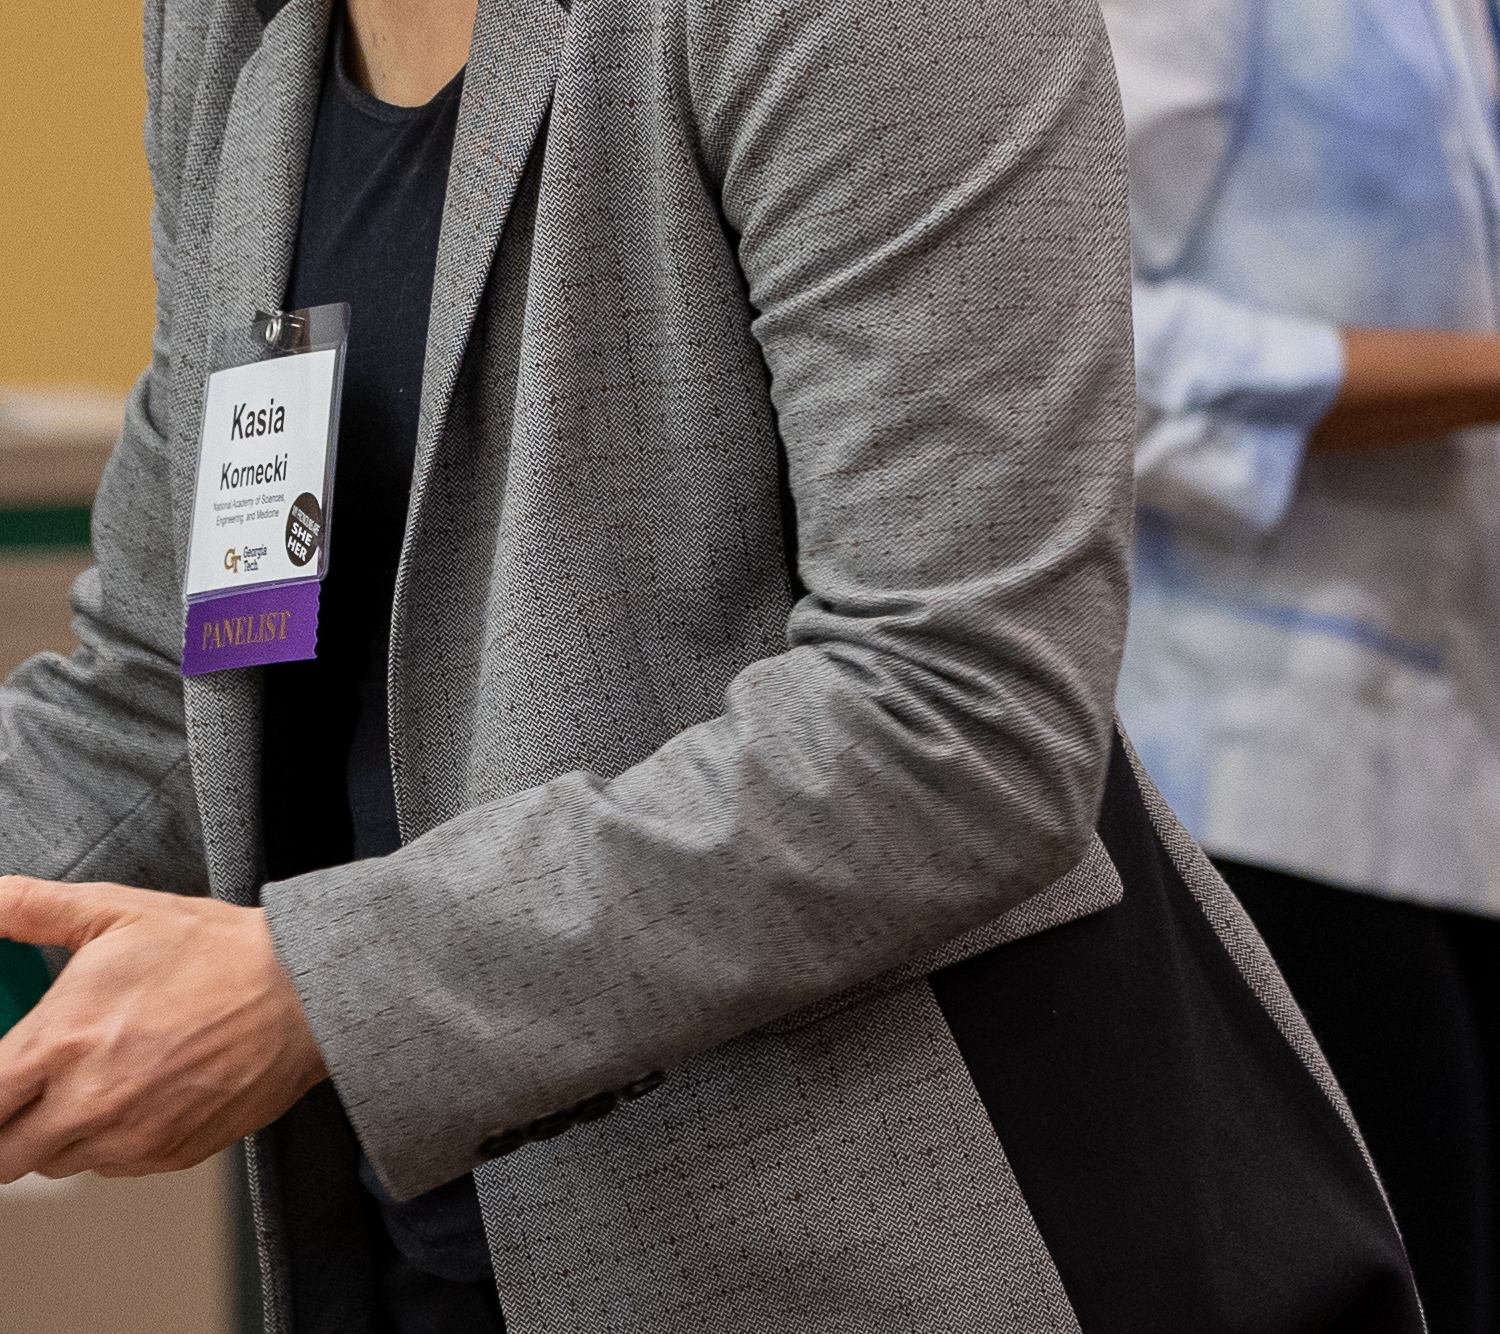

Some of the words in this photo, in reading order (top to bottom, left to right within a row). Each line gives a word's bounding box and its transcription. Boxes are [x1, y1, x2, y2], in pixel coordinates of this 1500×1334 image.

[231, 398, 285, 441] Kasia
[220, 453, 288, 491] Kornecki
[245, 511, 256, 522] and
[256, 509, 279, 520] Medicine
[291, 522, 313, 547] SHE
[224, 548, 242, 573] GT
[243, 544, 268, 559] Georgia
[287, 536, 308, 562] HER
[243, 559, 259, 572] Tech
[202, 610, 292, 651] PANELIST
